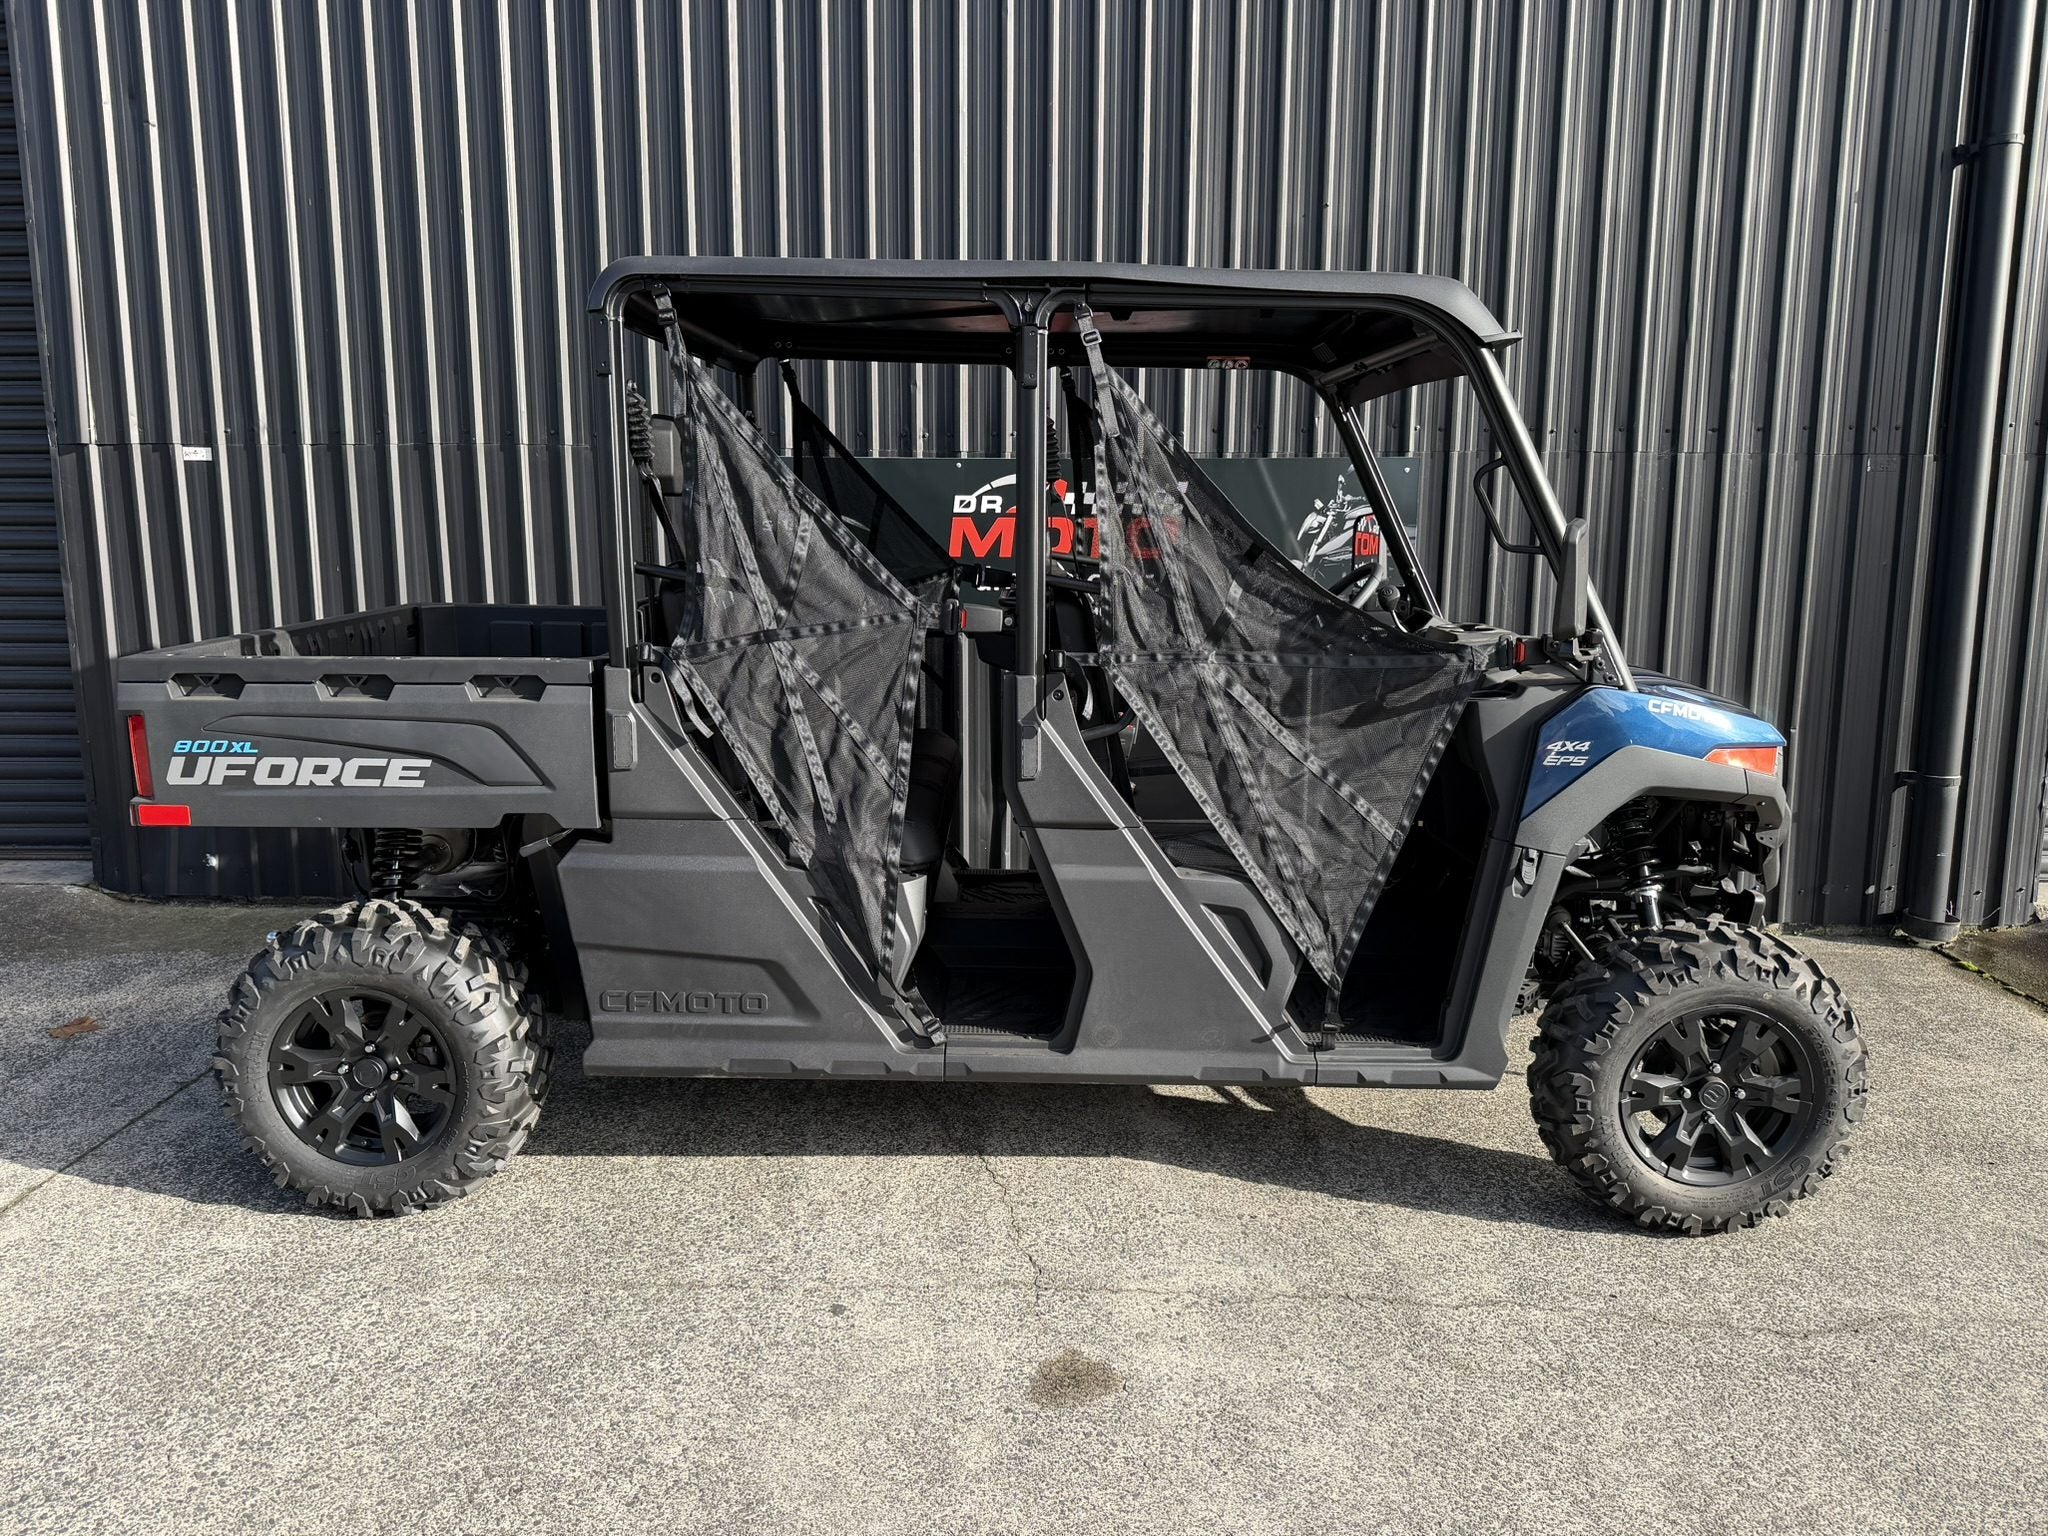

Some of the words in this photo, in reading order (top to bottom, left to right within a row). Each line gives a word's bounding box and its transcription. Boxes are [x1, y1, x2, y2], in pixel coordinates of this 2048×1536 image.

[953, 494, 1003, 514] DR
[1648, 699, 1732, 732] CFMO
[173, 740, 259, 754] 800XL
[1546, 740, 1591, 755] 4X4
[166, 756, 433, 788] UFORCE
[1542, 755, 1589, 767] EPS
[601, 989, 769, 1014] CFMOTO
[1759, 1156, 1811, 1201] CST
